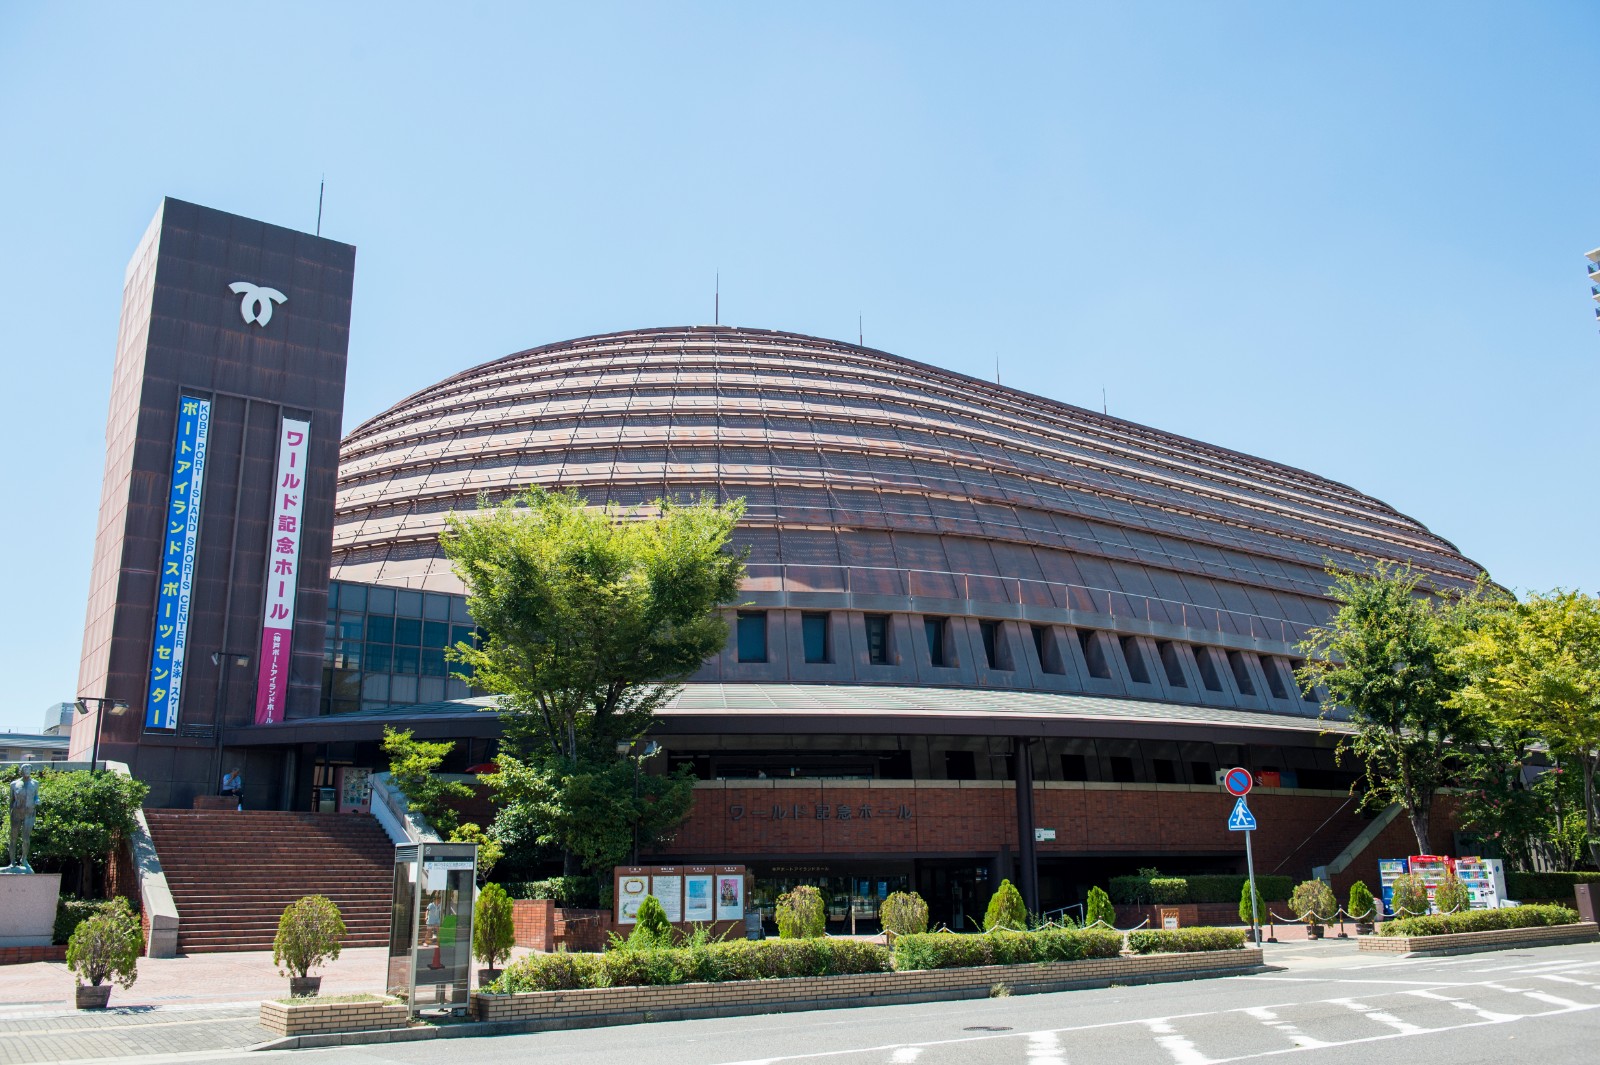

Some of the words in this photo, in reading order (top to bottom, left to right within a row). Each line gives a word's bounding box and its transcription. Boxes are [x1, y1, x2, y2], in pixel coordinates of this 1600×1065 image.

[198, 404, 208, 439] KOBE
[194, 442, 204, 476] PORT
[188, 480, 199, 532] ISLAND
[269, 430, 304, 620] ワールド記念ホール
[152, 402, 198, 725] ポートアイランドスポーツセンター
[182, 536, 194, 590] SPORTS
[176, 594, 189, 649] CENTER
[168, 659, 182, 726] 水泳・スケート
[730, 804, 913, 821] ワールド記念ホール
